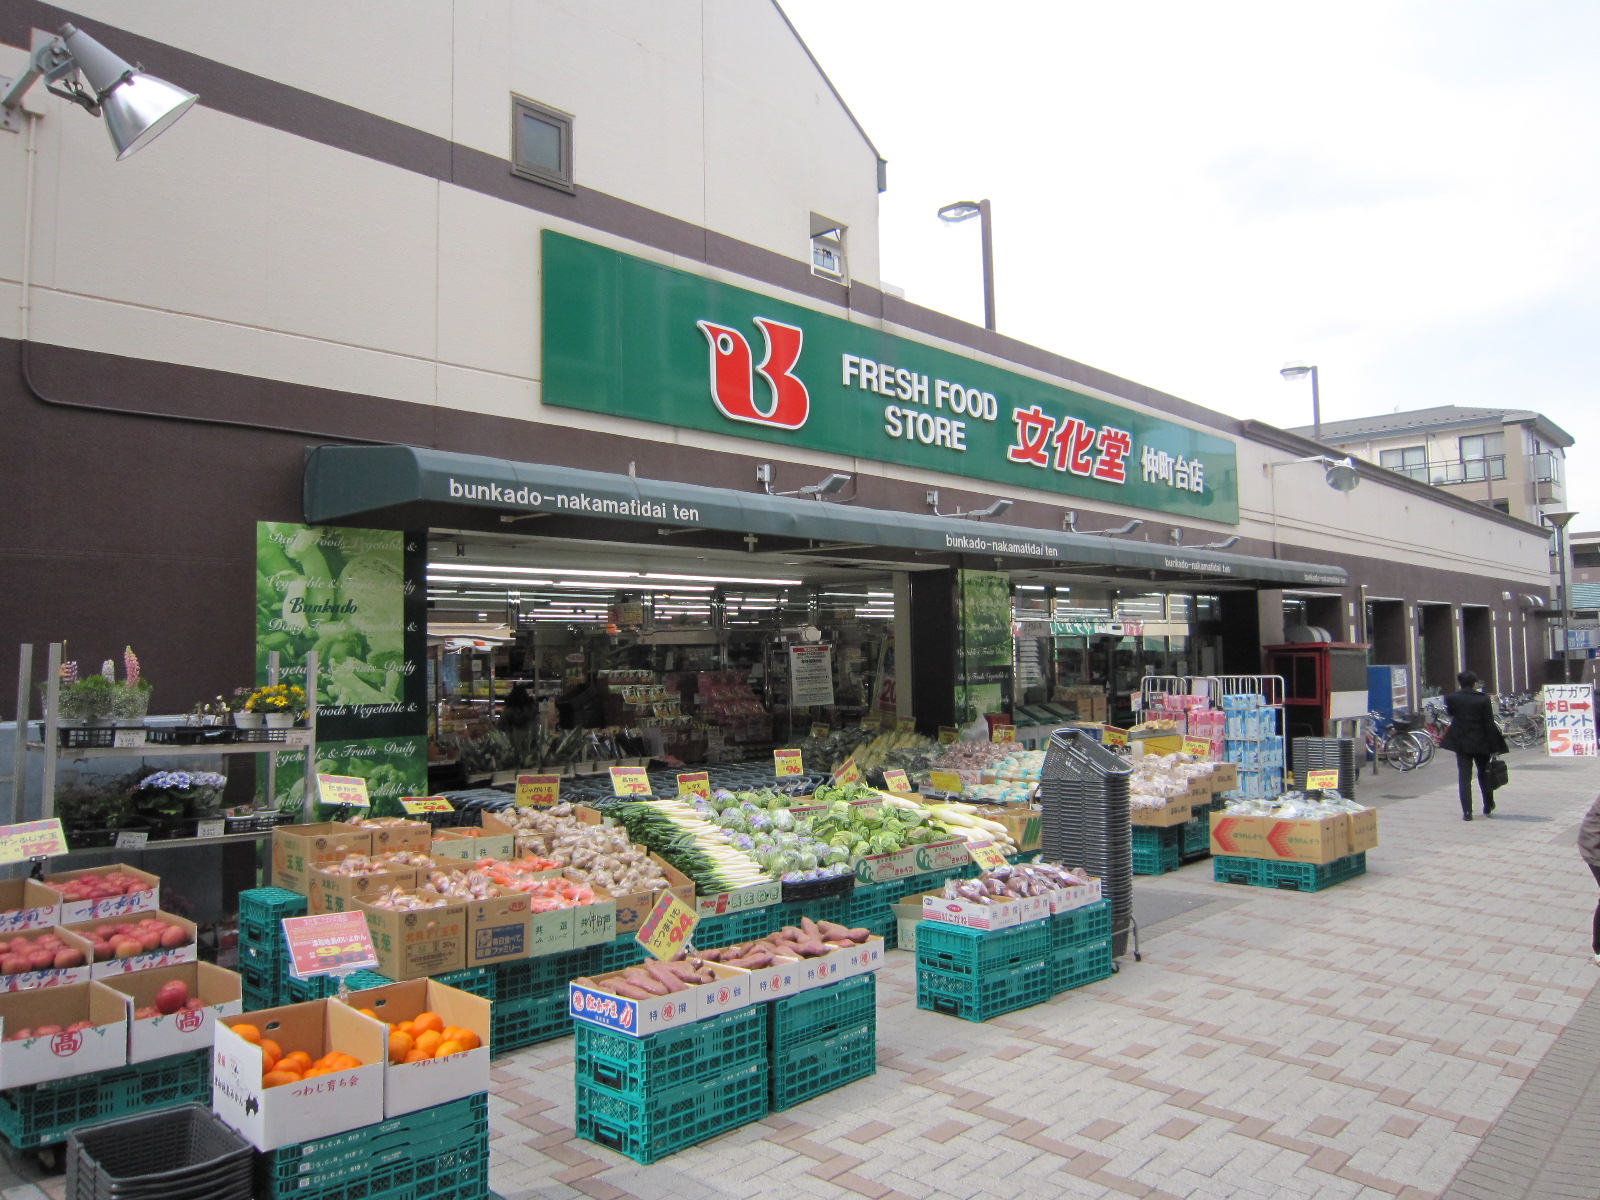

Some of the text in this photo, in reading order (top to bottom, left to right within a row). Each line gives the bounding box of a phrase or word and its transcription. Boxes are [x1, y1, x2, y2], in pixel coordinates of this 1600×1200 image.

[842, 353, 998, 421] FRESH FOOD
[885, 405, 967, 451] STORE
[1007, 405, 1132, 484] 文化堂
[1140, 445, 1204, 494] 仲町台店
[449, 478, 699, 521] bunkado-nakamatidai ten
[407, 541, 417, 551] &
[946, 534, 1058, 557] bunkado-nakamatidai ten
[1165, 557, 1231, 574] bunkado-nakamatidai ten
[328, 579, 337, 588] &
[289, 597, 358, 615] Bunkado
[407, 622, 418, 632] &
[384, 660, 417, 676] Daily
[1545, 686, 1591, 699] ヤナガワ
[350, 702, 404, 718] Vegetable
[407, 703, 418, 712] &
[1546, 700, 1569, 713] 本日
[1547, 714, 1593, 727] ポイント
[328, 741, 417, 759] & Fruits Daily
[627, 783, 648, 793] 75
[337, 792, 365, 804] 94
[531, 793, 555, 804] 94
[21, 840, 64, 857] 132
[941, 912, 969, 926] 紅こがね
[653, 907, 681, 948] さつまいも
[669, 913, 694, 943] 94
[316, 942, 365, 957] 94
[586, 993, 618, 1019] 紅あずま
[649, 1010, 658, 1021] 特
[291, 1074, 360, 1098] つわじ育ち会
